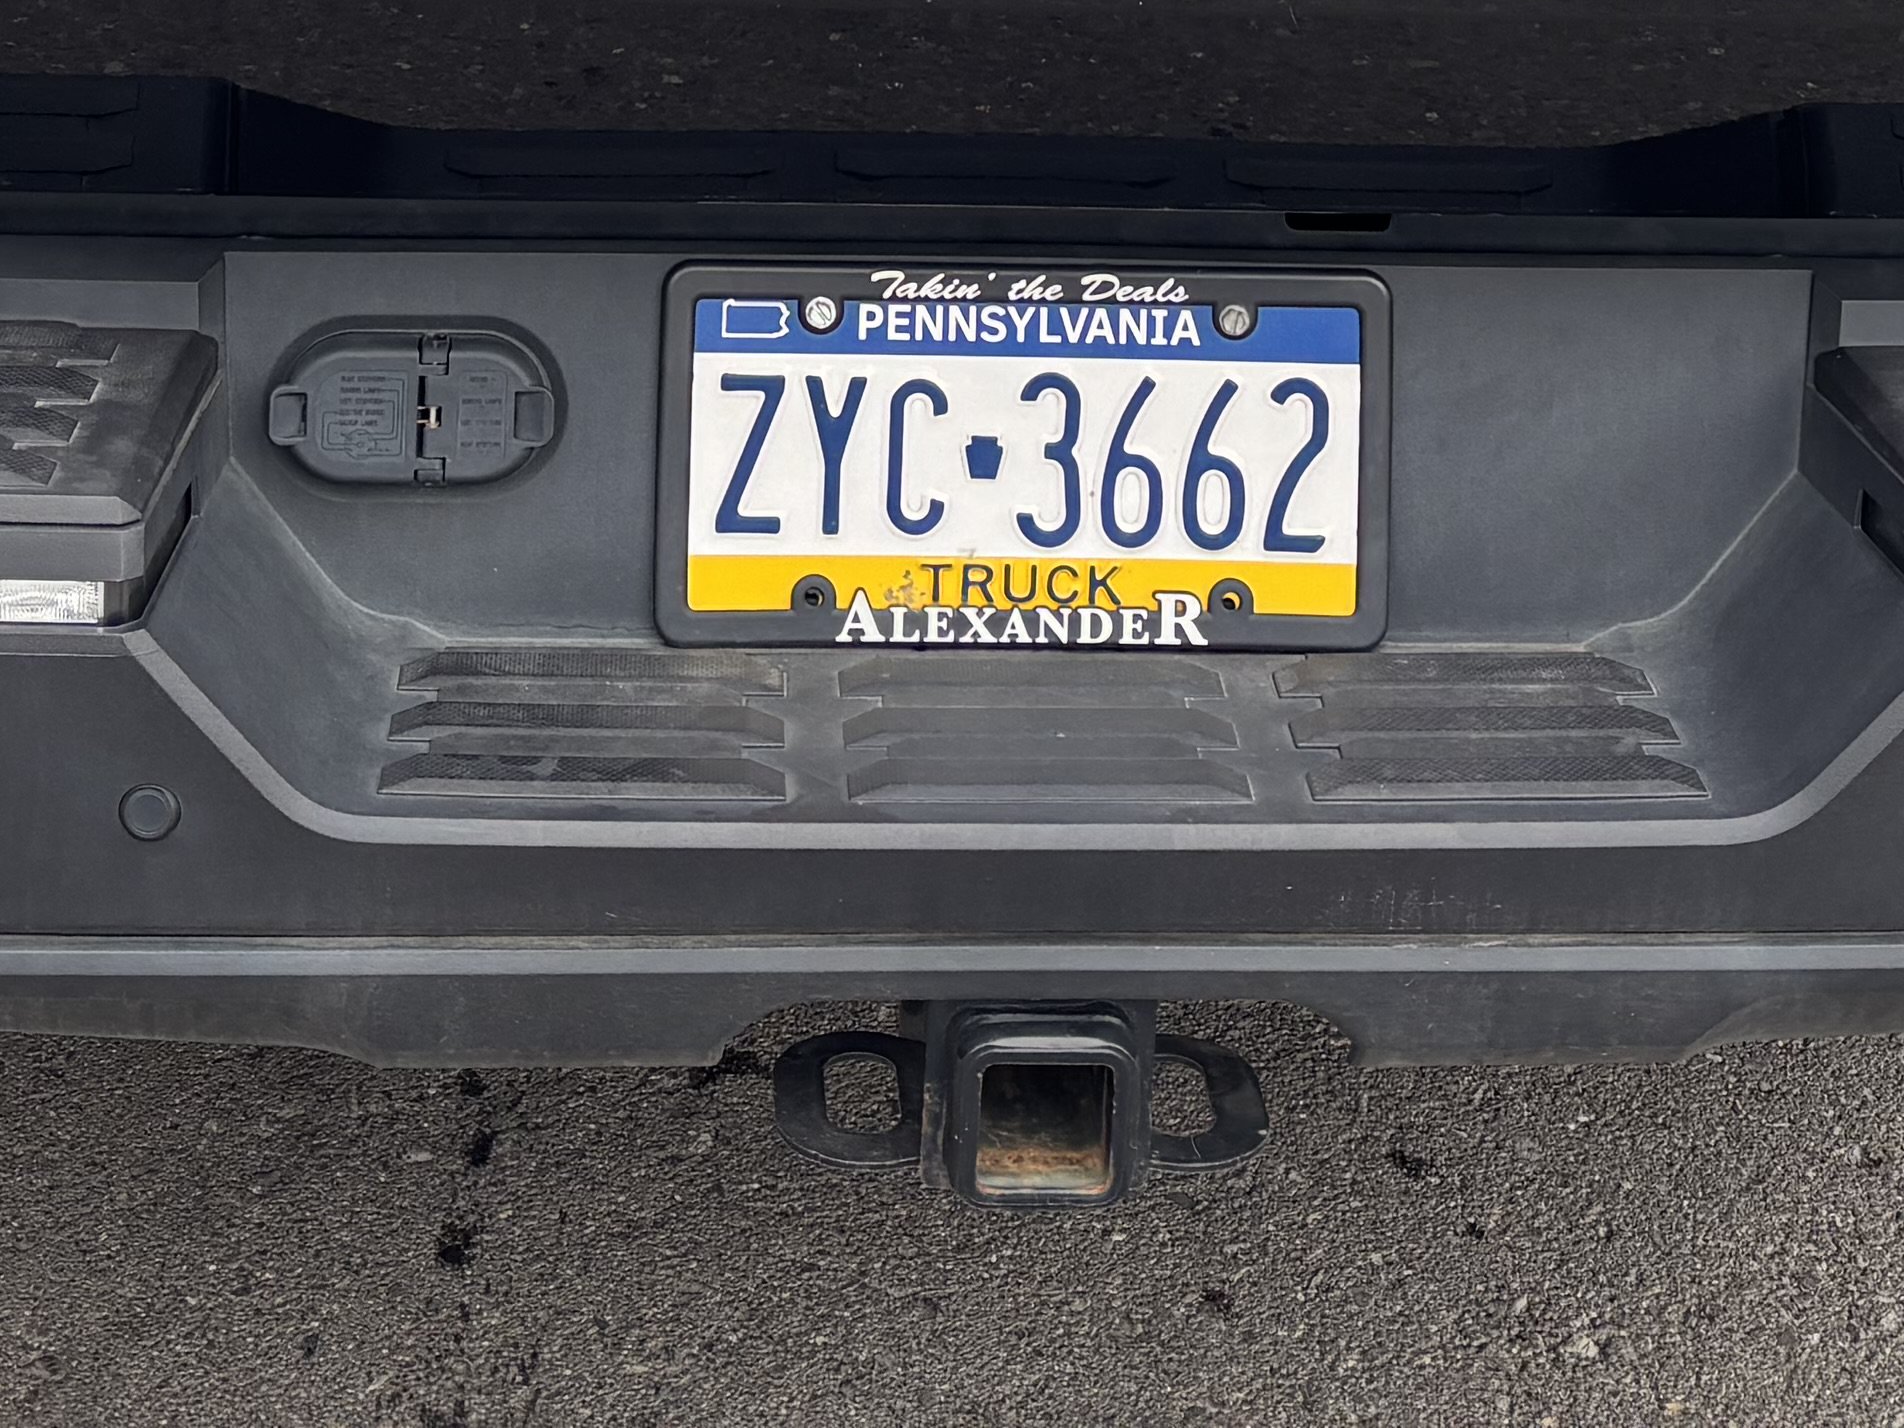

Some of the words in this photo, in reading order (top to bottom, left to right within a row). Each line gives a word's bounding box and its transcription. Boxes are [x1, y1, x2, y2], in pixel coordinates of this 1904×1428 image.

[870, 270, 996, 302] Takin'
[1008, 273, 1063, 302] the
[1080, 275, 1189, 304] Deals
[857, 304, 1200, 346] PENNSYLVANIA
[919, 563, 1122, 606] TRUCK
